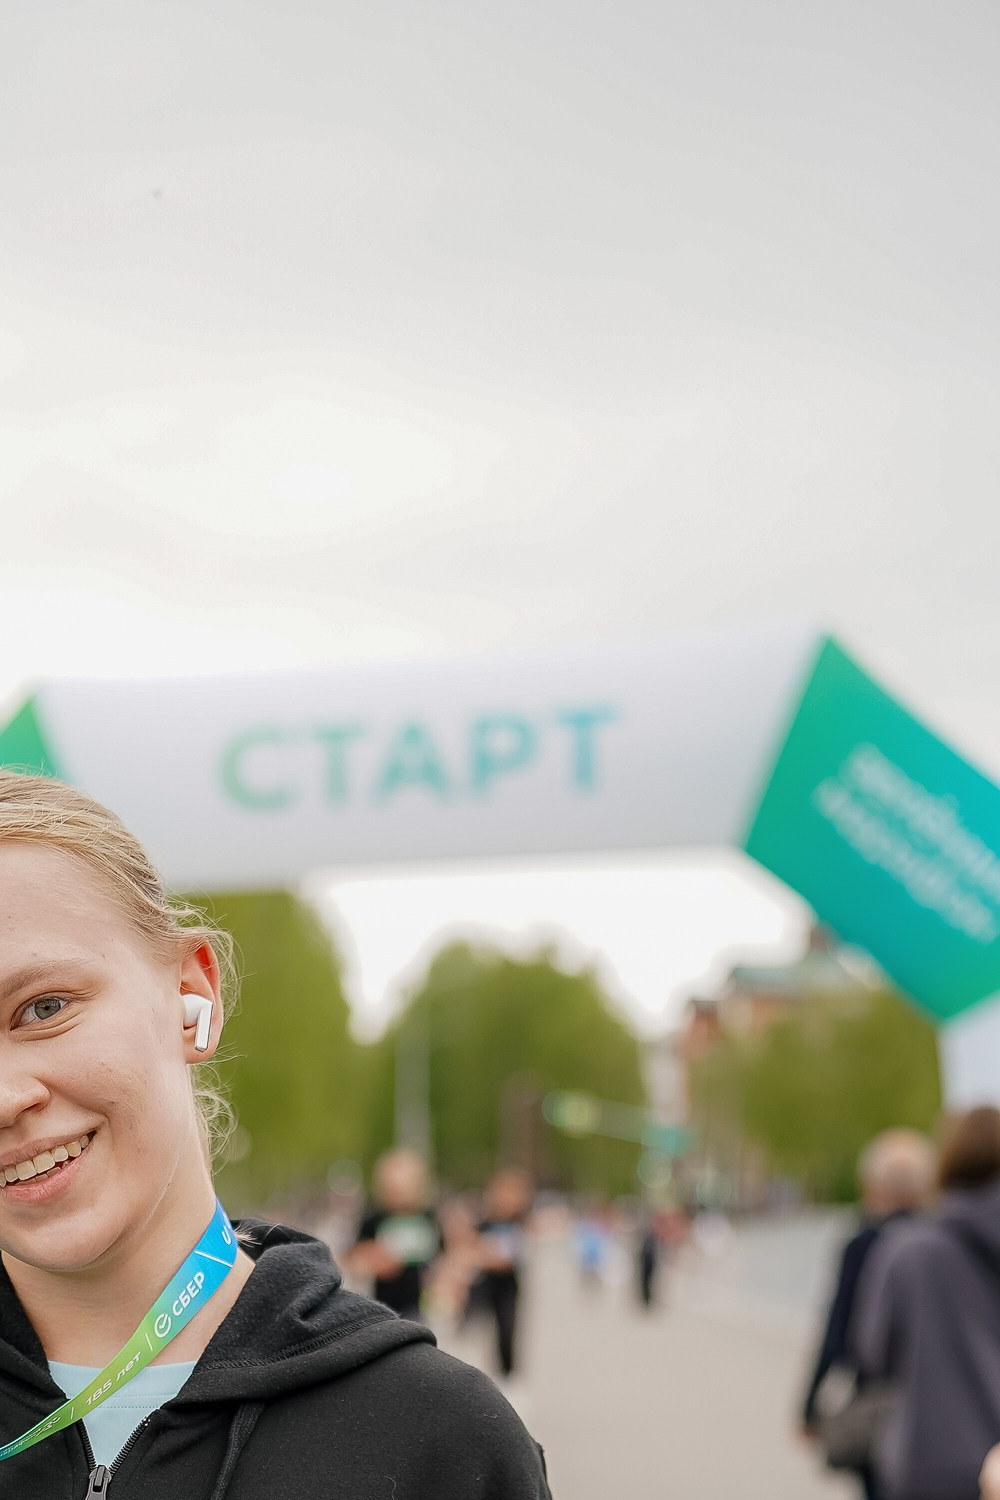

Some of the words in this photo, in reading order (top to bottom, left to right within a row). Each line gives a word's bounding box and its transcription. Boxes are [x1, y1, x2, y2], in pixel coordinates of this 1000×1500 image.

[217, 702, 622, 813] СТАРТ
[172, 1271, 205, 1316] СБЕР
[85, 1379, 113, 1406] 185
[116, 1351, 141, 1381] лет
